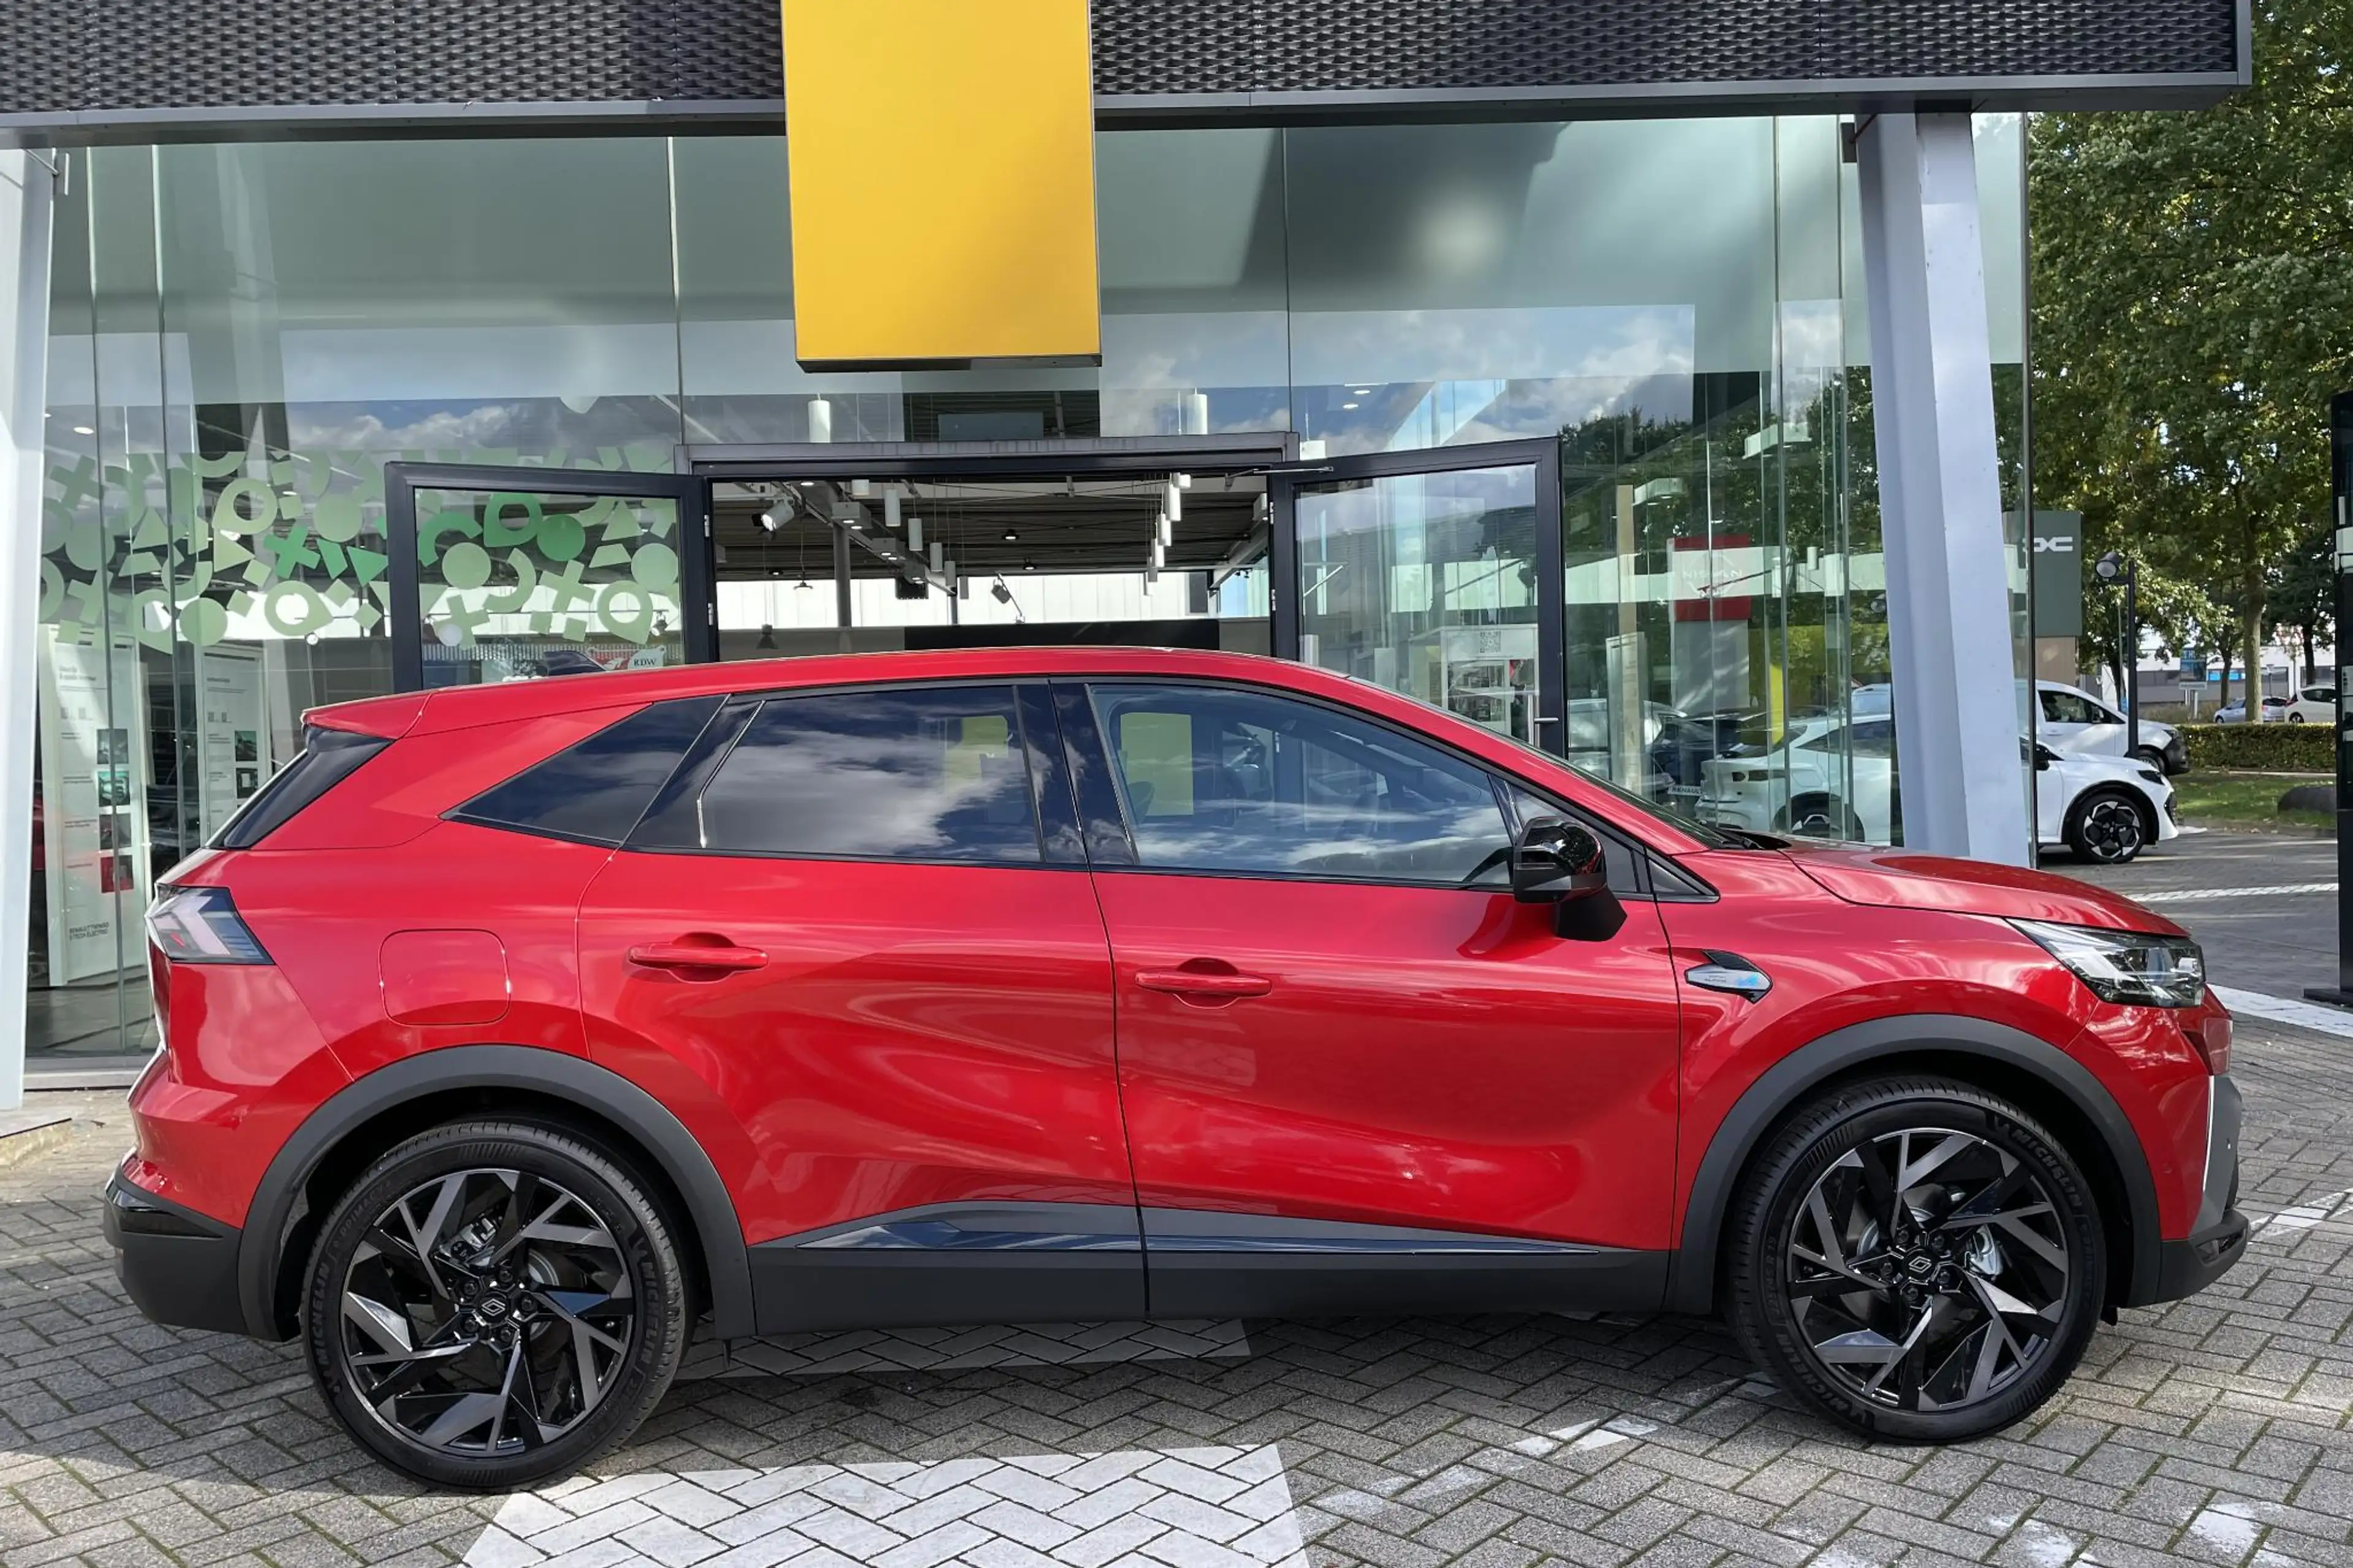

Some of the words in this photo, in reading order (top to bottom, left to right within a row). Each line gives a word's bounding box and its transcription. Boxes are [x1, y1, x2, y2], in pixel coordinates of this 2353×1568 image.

[2012, 1129, 2083, 1205] MICHELIN
[312, 1261, 330, 1365] MICHELIN
[639, 1262, 659, 1365] MICHELIN
[1775, 1333, 1849, 1411] MICHELIN
